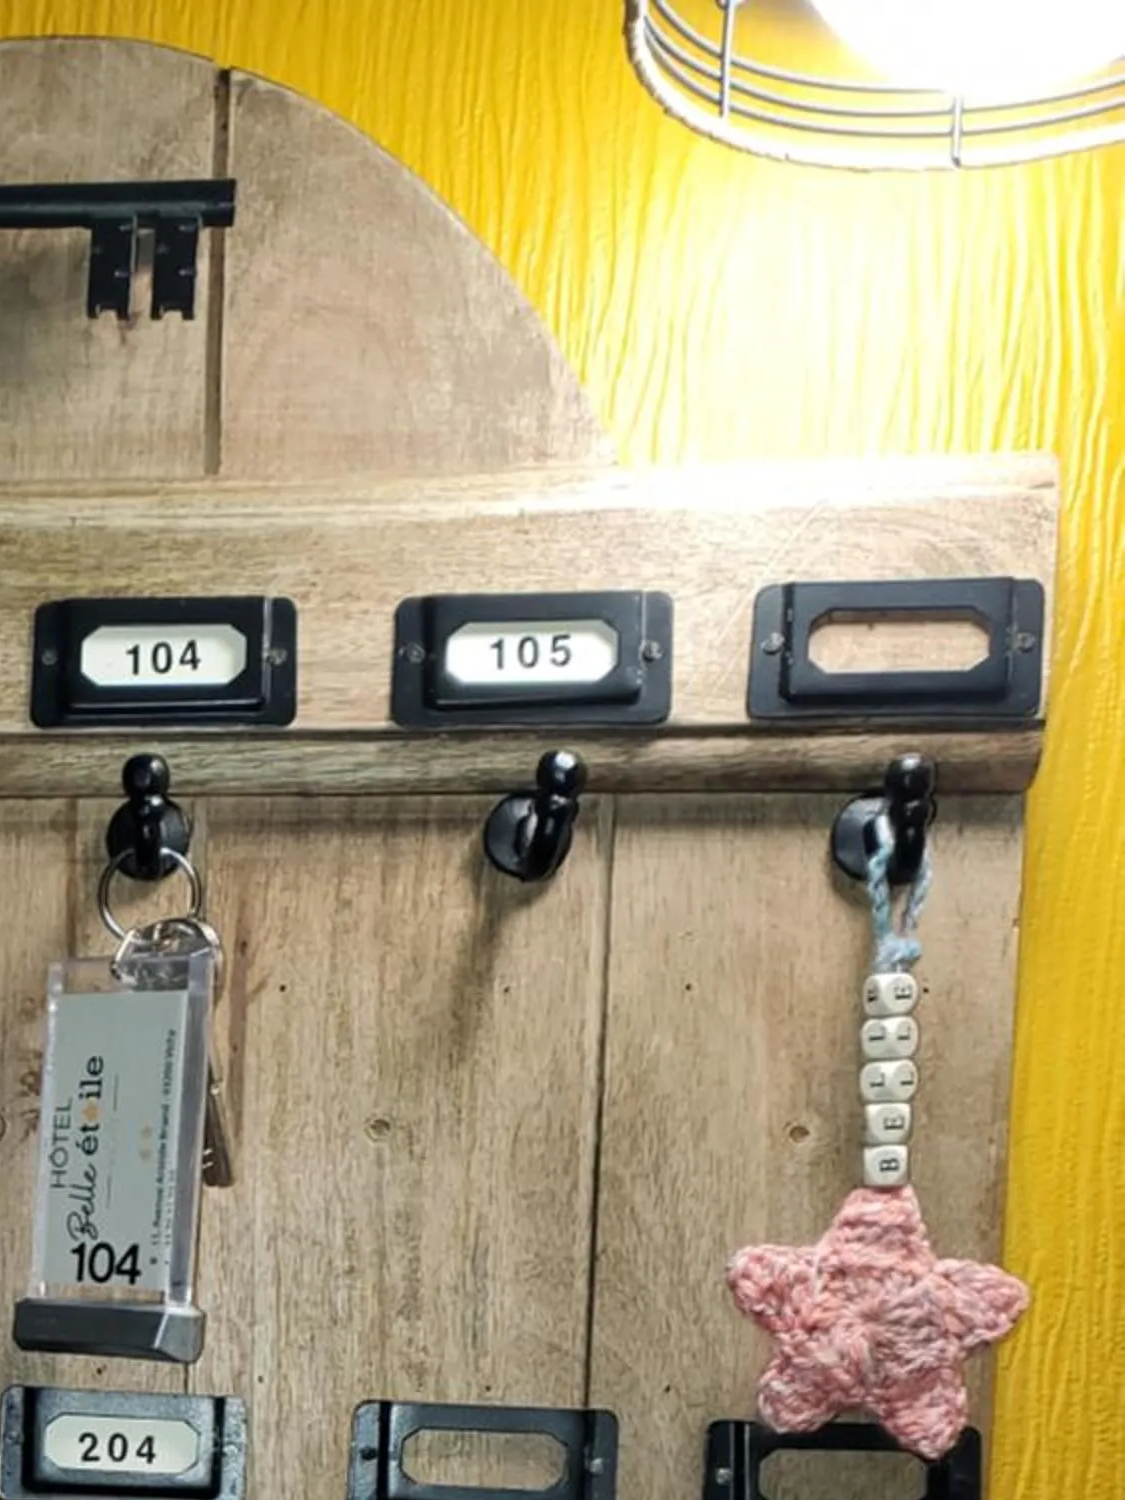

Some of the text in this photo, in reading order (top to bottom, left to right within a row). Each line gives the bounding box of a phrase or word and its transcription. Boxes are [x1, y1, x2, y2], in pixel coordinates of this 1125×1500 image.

[127, 640, 200, 675] 104
[490, 634, 573, 671] 105
[67, 1055, 105, 1241] Belle étile
[70, 1242, 142, 1285] 104
[79, 1432, 155, 1464] 204
